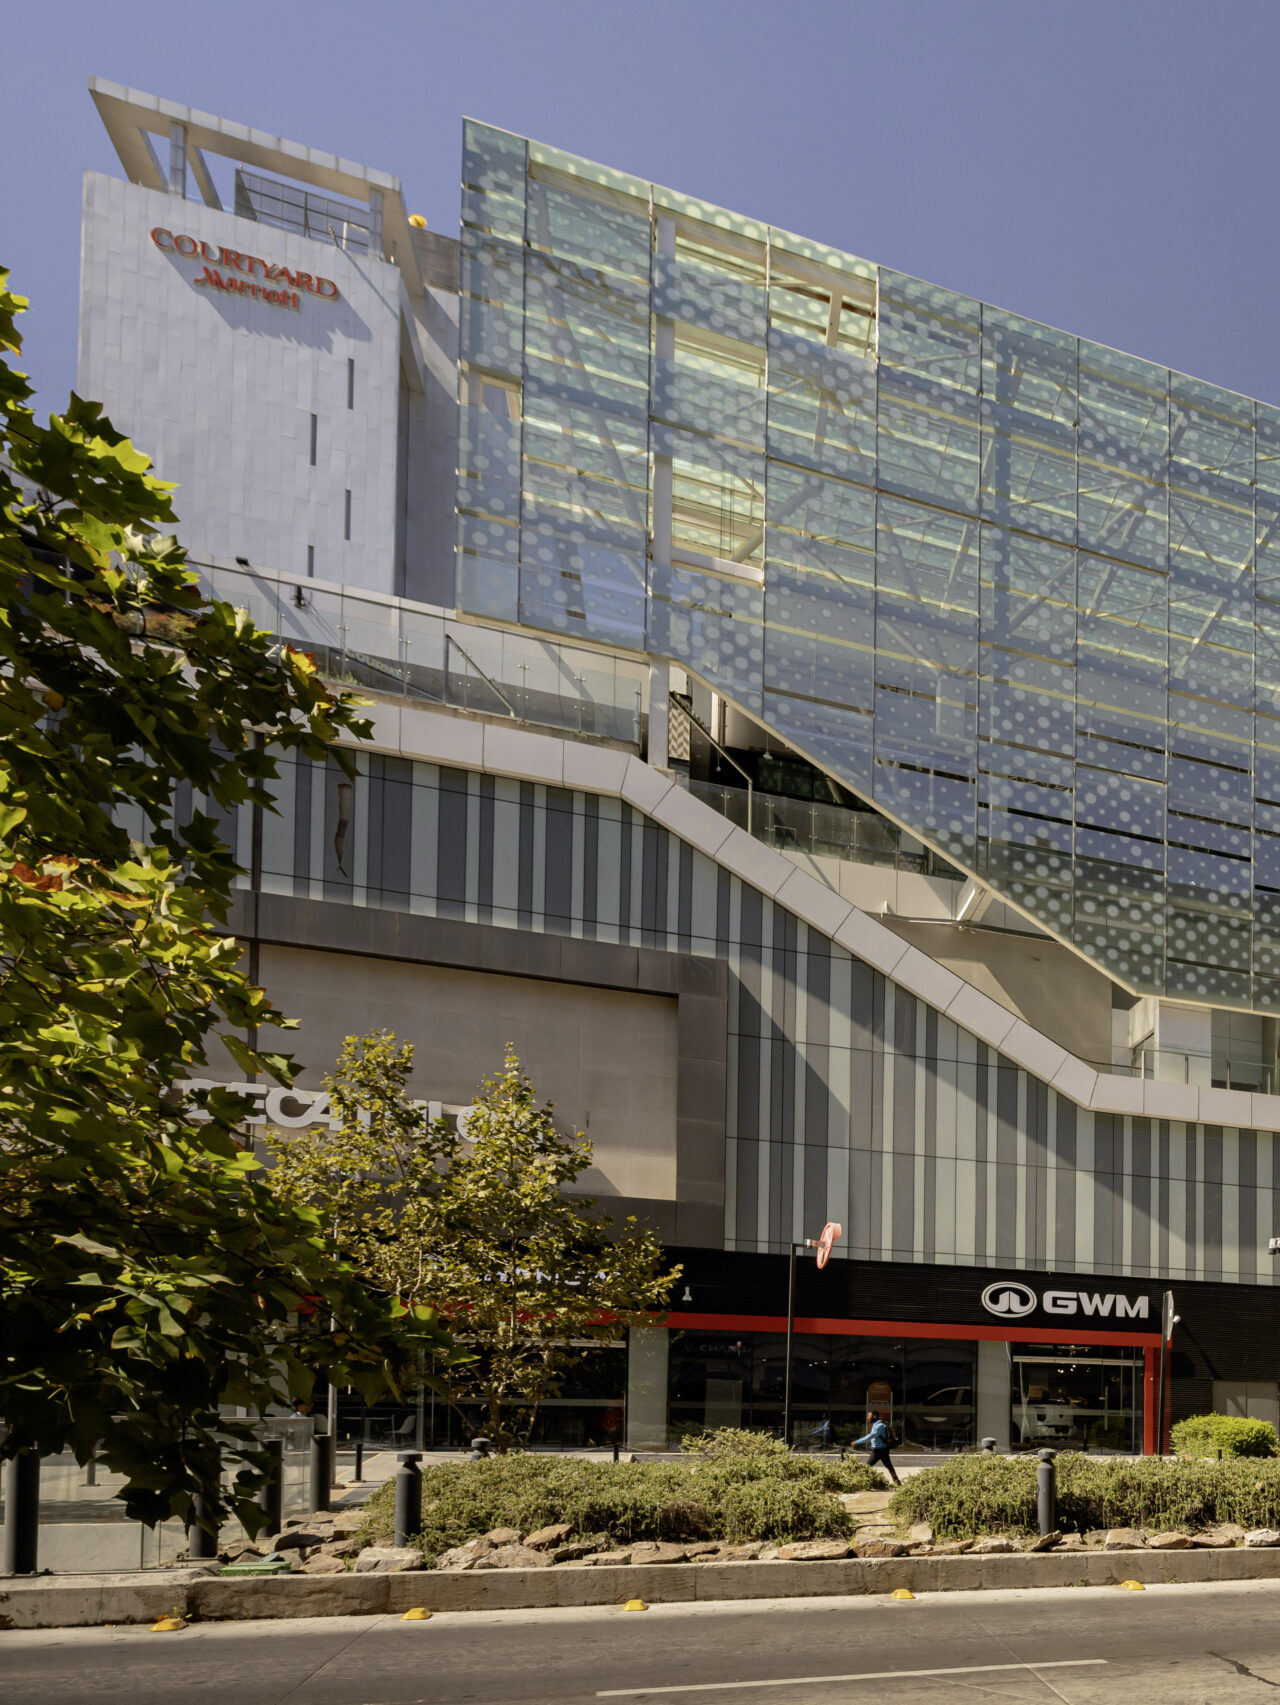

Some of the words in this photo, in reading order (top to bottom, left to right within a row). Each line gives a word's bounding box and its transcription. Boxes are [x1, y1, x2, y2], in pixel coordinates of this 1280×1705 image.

[150, 227, 338, 300] COURTYARD
[194, 266, 300, 313] Marriott
[1042, 1290, 1149, 1318] GWM
